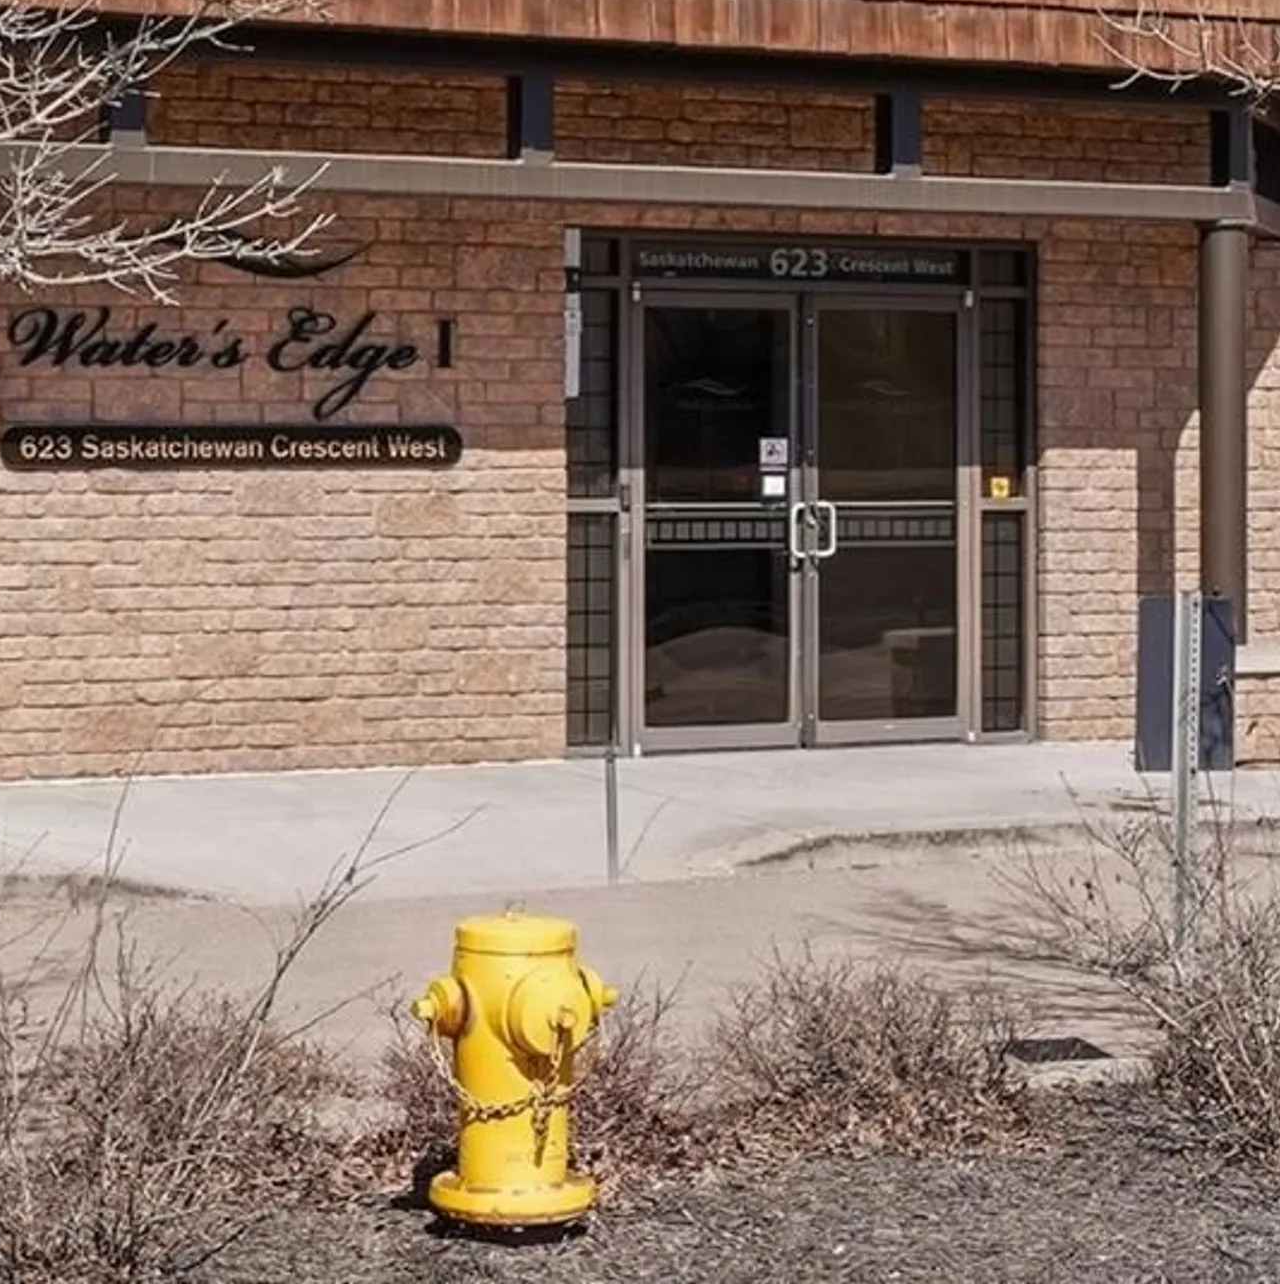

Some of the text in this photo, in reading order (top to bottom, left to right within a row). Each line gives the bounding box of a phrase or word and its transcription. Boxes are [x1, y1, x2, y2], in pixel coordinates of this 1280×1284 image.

[638, 247, 955, 278] Saskatchewan 623 Crescent West
[7, 306, 249, 370] Water's
[266, 306, 420, 418] Edge
[19, 433, 447, 461] 623 Saskatchewan Crescent West
